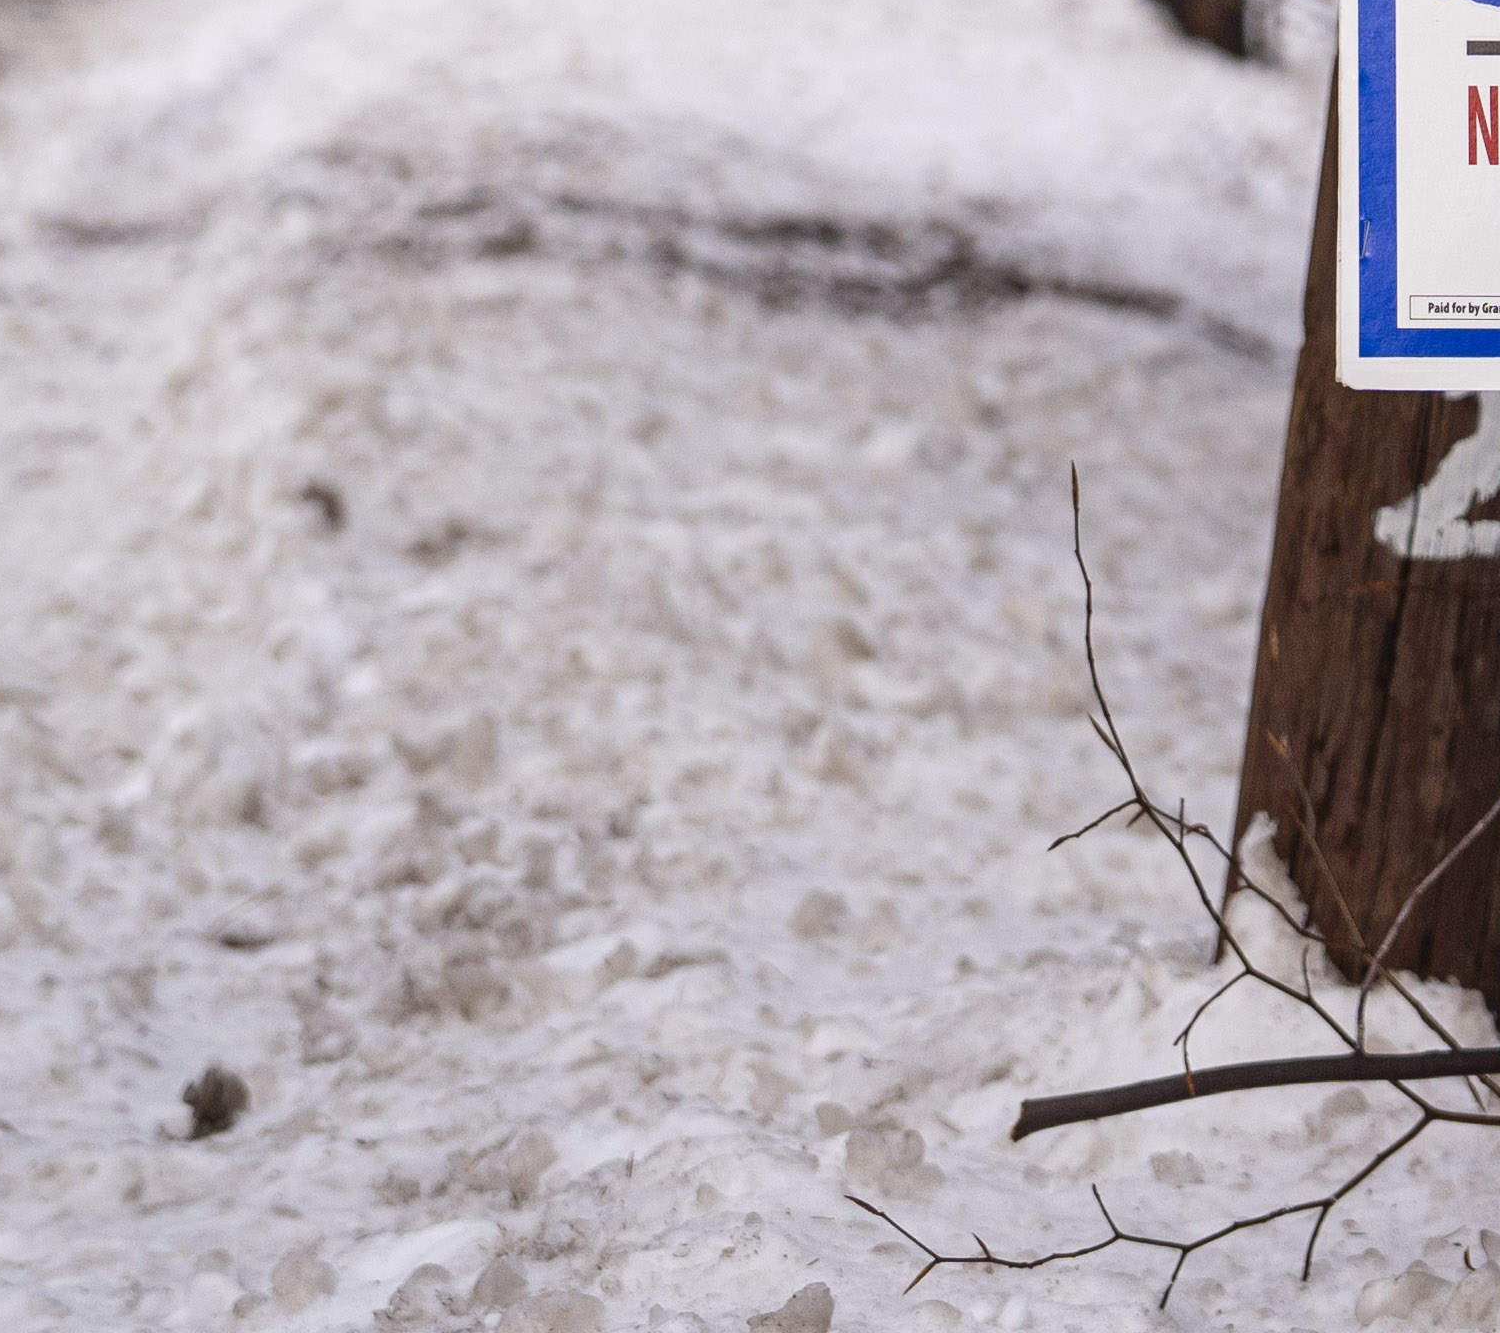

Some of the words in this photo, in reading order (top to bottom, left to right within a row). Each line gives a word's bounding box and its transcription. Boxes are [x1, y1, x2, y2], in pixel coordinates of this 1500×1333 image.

[1428, 302, 1450, 315] Paid
[1451, 302, 1467, 315] for
[1468, 303, 1480, 317] by
